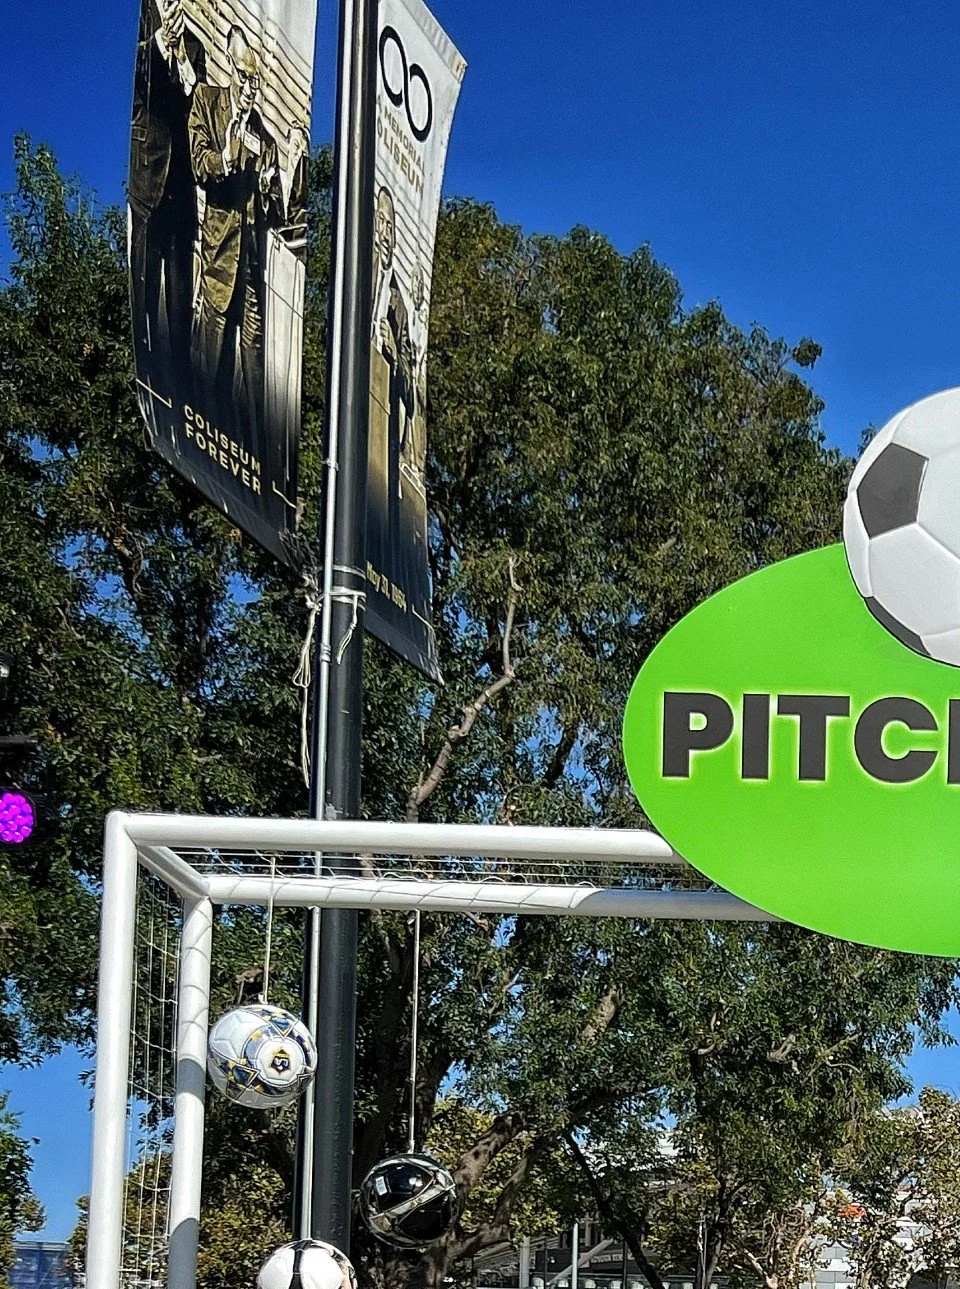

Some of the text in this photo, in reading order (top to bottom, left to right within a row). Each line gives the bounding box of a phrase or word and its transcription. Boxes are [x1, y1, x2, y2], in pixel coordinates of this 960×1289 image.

[377, 116, 425, 200] OLISEUM
[184, 404, 261, 476] COLISEUM
[184, 421, 262, 496] FOREVER
